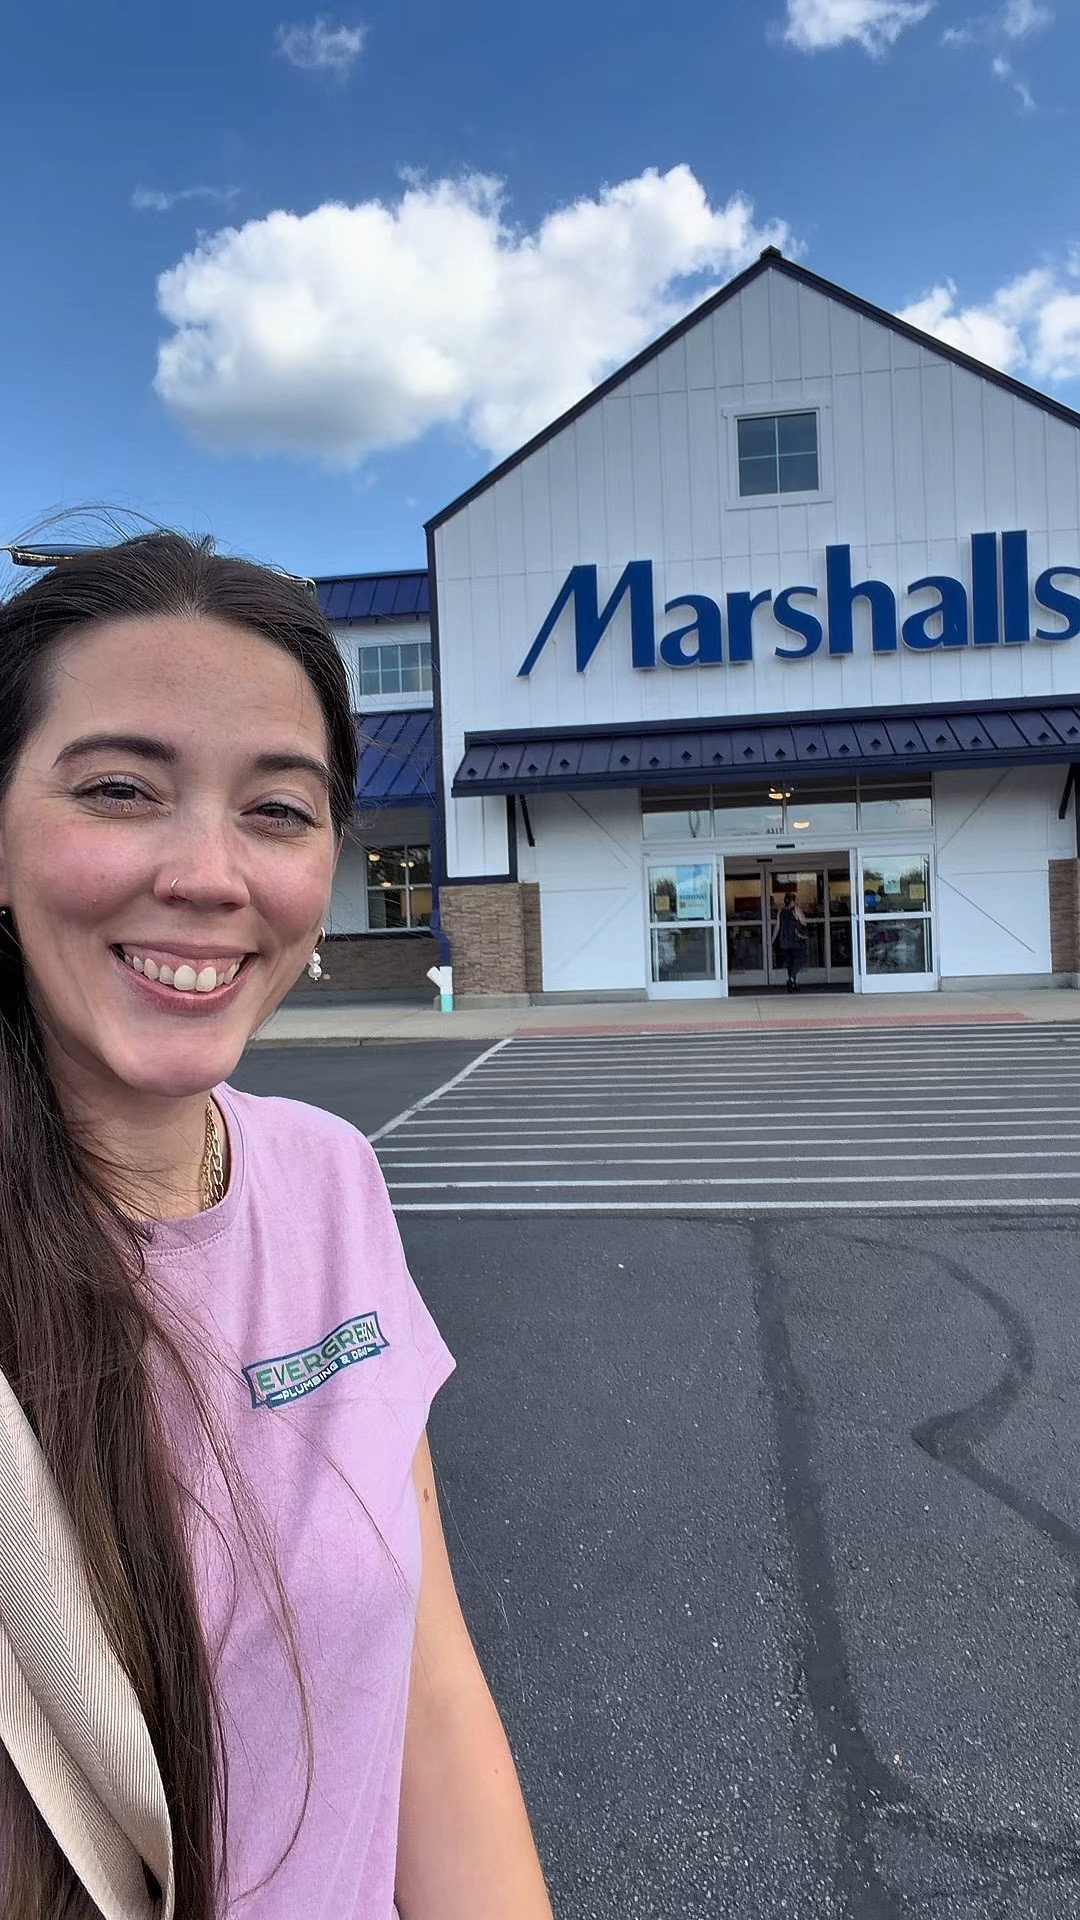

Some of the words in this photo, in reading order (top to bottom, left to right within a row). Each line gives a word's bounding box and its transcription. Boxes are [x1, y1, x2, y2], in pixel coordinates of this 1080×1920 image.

[517, 529, 1080, 678] Marshalls
[256, 1320, 377, 1391] EVERGREN
[282, 1361, 339, 1401] PLUMBING
[340, 1355, 351, 1366] &
